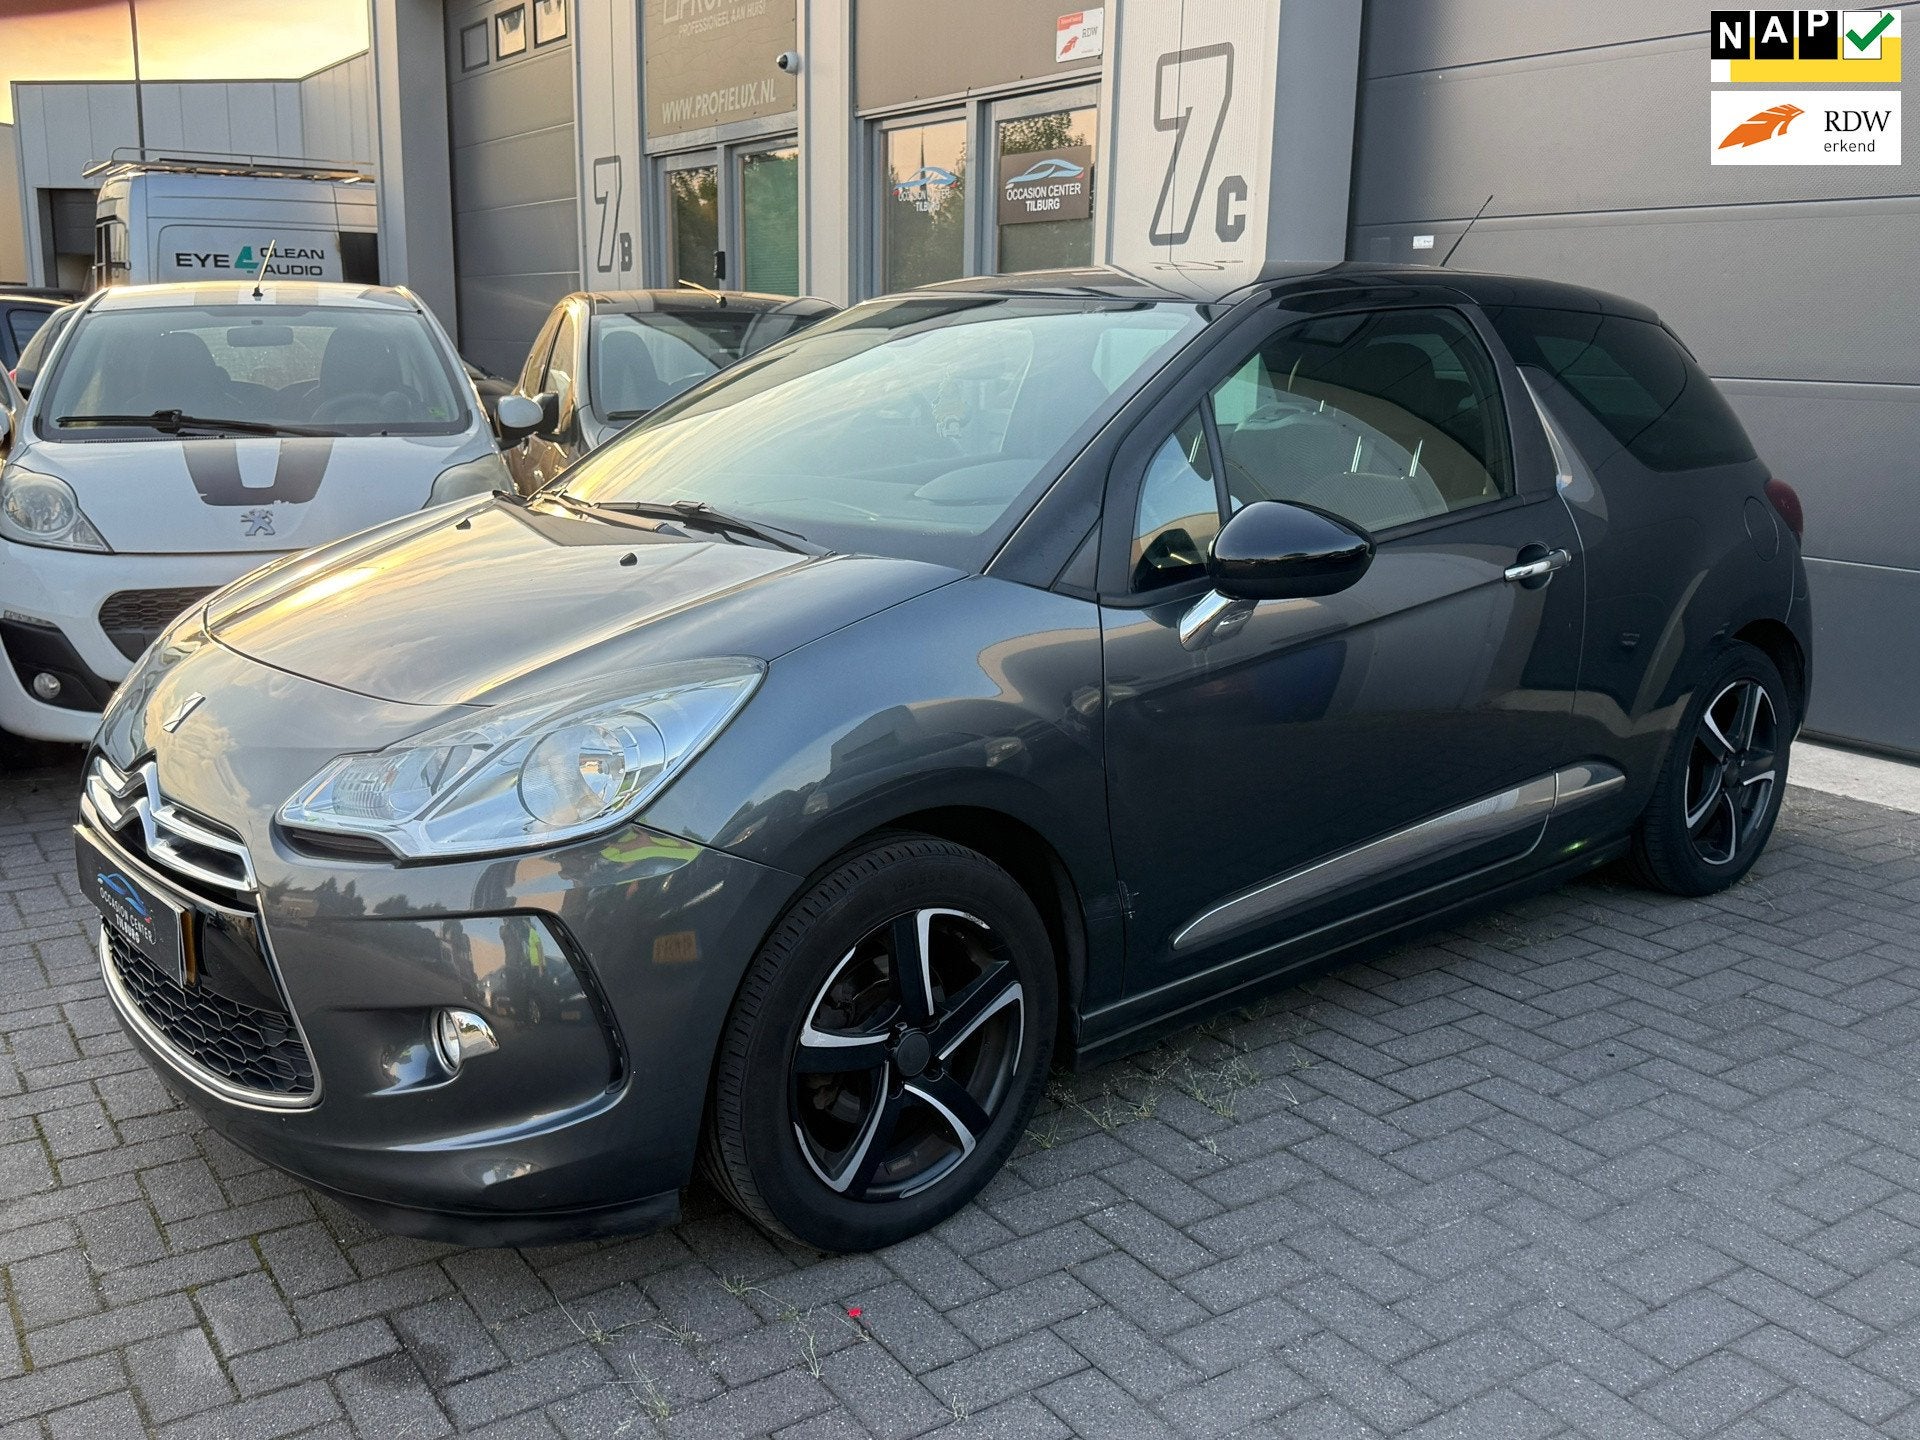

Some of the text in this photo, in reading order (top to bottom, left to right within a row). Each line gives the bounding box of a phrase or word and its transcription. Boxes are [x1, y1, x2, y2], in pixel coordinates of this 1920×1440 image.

[662, 78, 777, 124] WWW.PROFIELUX.NL
[1006, 182, 1082, 201] OCCASION CENTER
[1026, 198, 1060, 212] TILBURG
[260, 247, 325, 260] CLEAN
[263, 264, 323, 276] AUDIO
